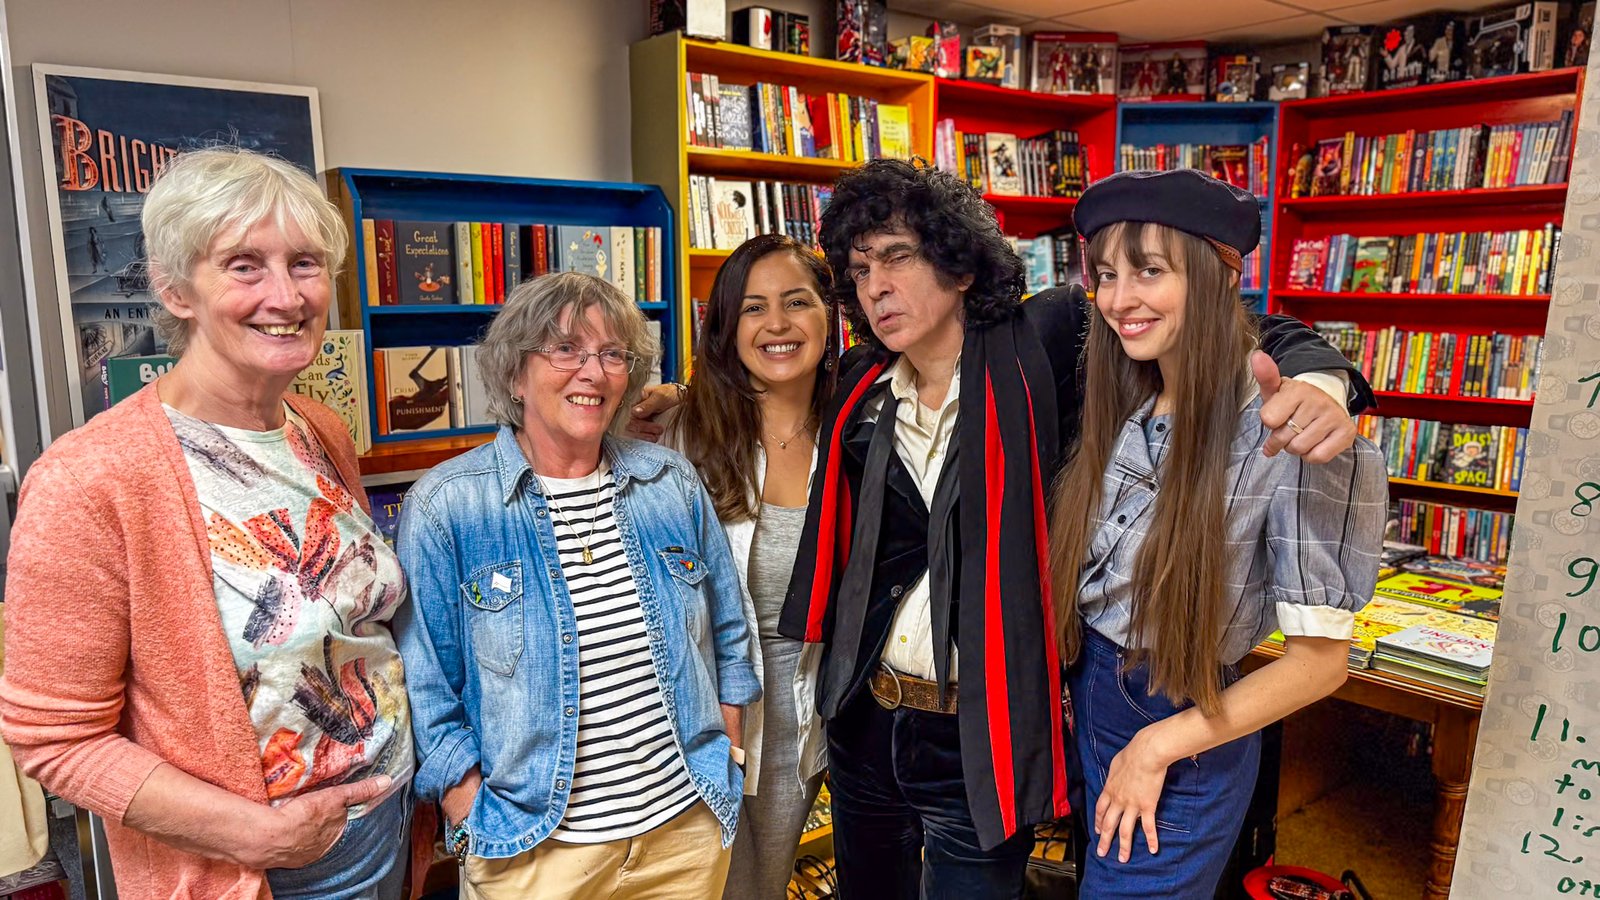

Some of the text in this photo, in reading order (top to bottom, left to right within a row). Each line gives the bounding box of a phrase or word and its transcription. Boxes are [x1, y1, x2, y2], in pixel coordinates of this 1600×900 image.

[414, 230, 438, 243] Great
[405, 244, 449, 258] Expectations
[105, 308, 120, 319] AN
[293, 383, 330, 404] Fly
[1566, 557, 1599, 597] 9
[1552, 612, 1600, 652] 10
[1555, 774, 1591, 800] to
[1521, 831, 1583, 863] 12.
